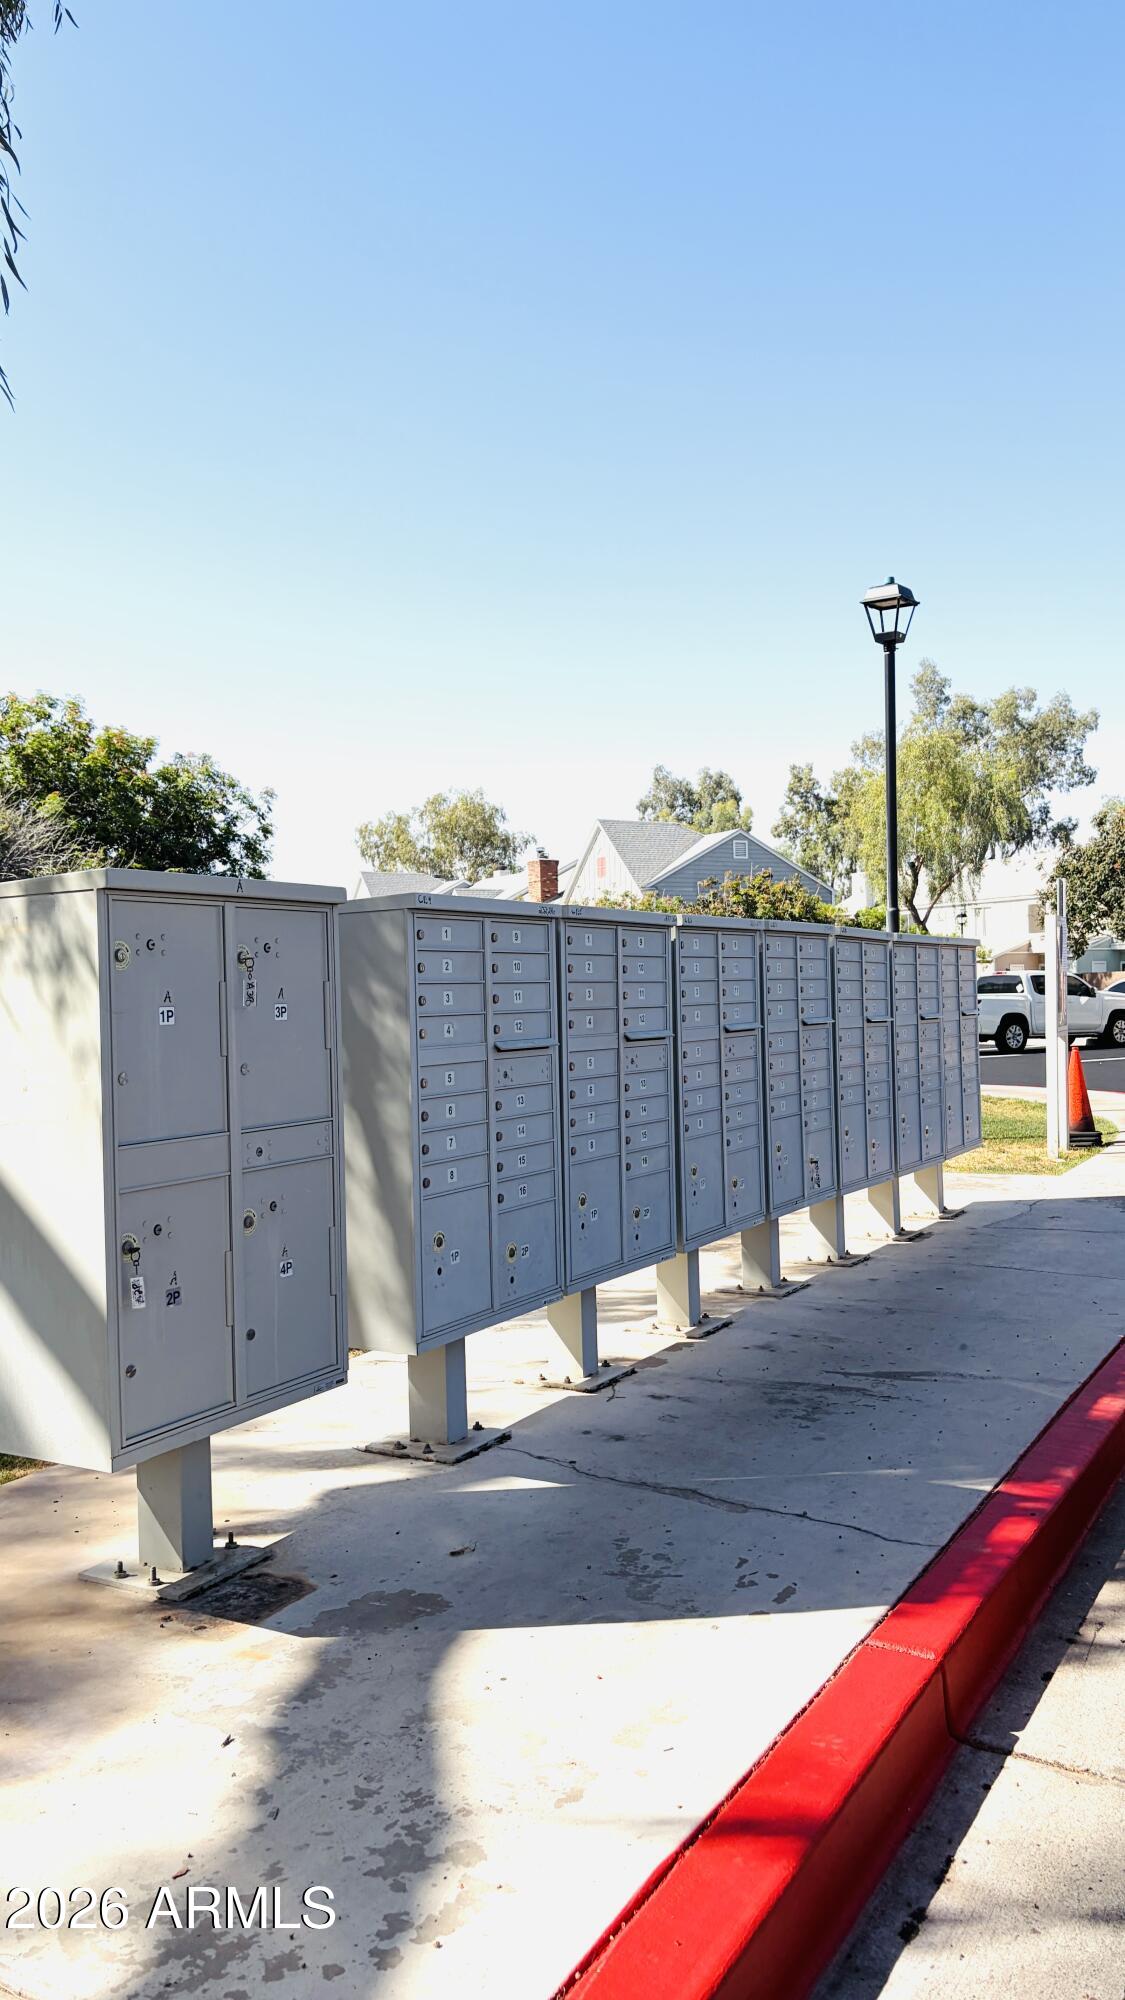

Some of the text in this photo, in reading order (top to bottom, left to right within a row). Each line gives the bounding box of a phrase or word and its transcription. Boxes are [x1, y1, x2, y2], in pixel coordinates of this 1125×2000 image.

[513, 932, 519, 941] 9
[444, 961, 450, 971] 2
[514, 962, 521, 971] 10
[164, 990, 171, 1003] A
[445, 994, 451, 1003] 3
[514, 992, 521, 1001] 11
[160, 1010, 174, 1023] 1P
[275, 1006, 287, 1018] 3P
[446, 1026, 451, 1035] 4
[515, 1021, 522, 1031] 12
[447, 1073, 452, 1083] 5
[517, 1096, 525, 1105] 13
[448, 1105, 453, 1115] 6
[518, 1126, 525, 1135] 14
[448, 1138, 453, 1147] 7
[518, 1155, 526, 1165] 15
[449, 1170, 454, 1180] 8
[519, 1186, 527, 1195] 16
[591, 1209, 598, 1219] 1P
[450, 1251, 459, 1262] 1P
[521, 1246, 529, 1257] 2P
[280, 1261, 292, 1274] 4P
[166, 1290, 180, 1306] 2P
